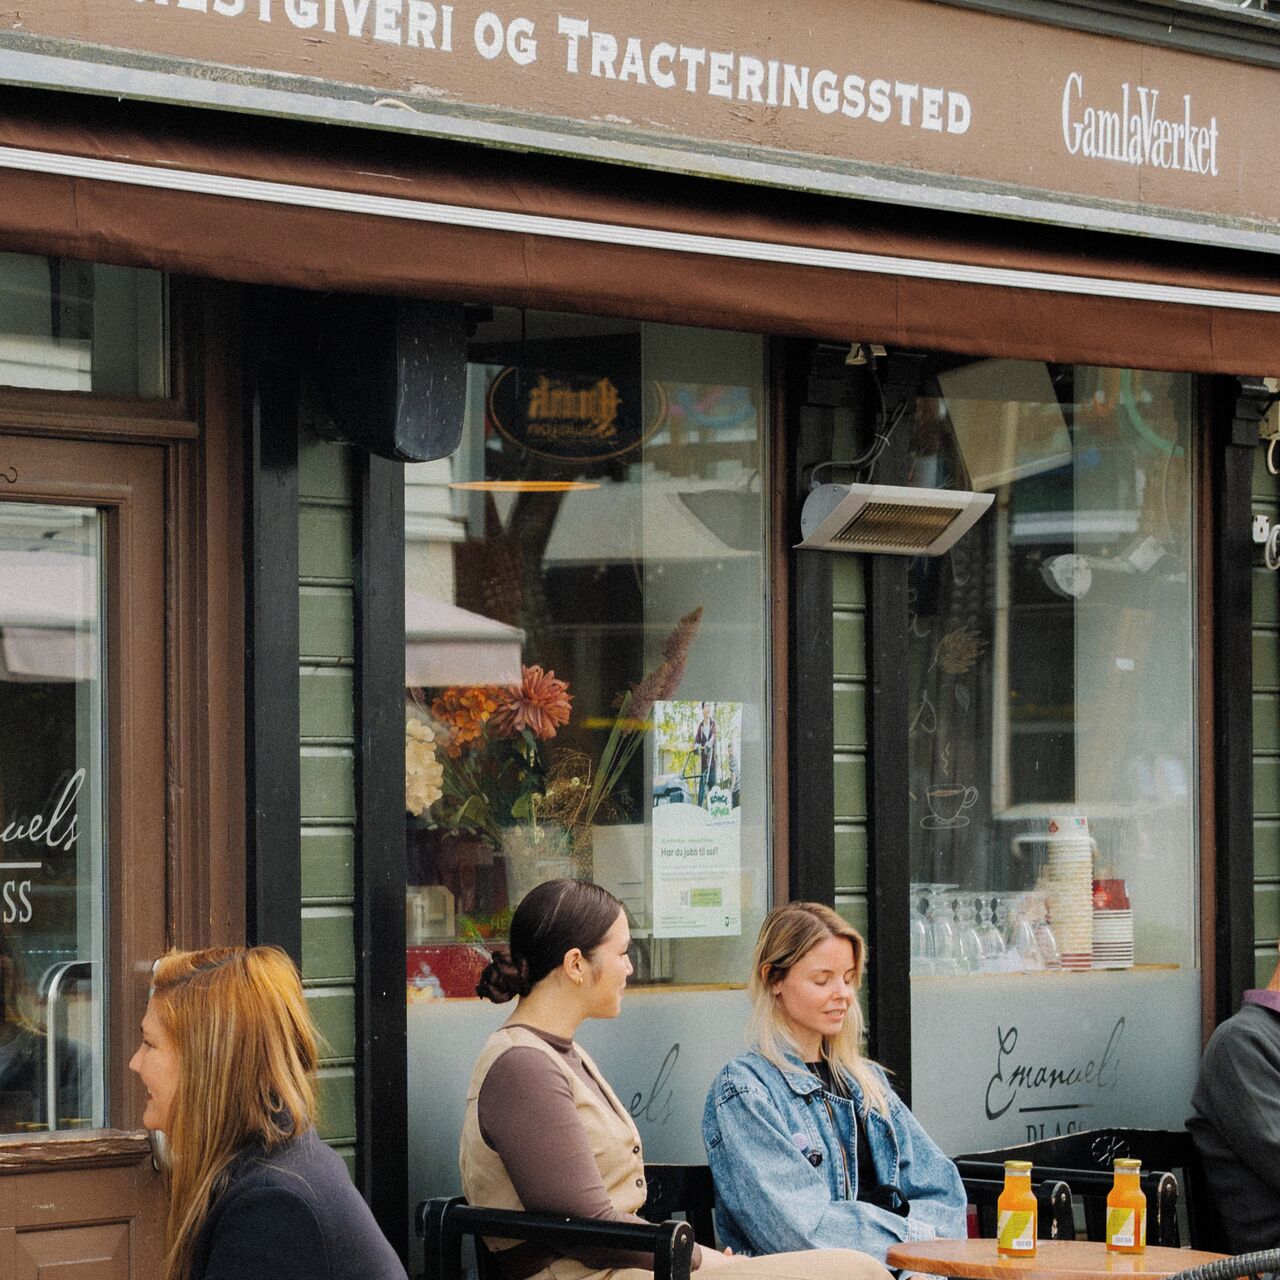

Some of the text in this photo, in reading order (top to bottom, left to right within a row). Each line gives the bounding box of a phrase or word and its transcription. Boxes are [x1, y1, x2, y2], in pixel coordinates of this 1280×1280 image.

[473, 10, 539, 66] OG
[557, 13, 973, 135] TRACTERINGSSTED
[1061, 71, 1221, 177] GamlaVærket
